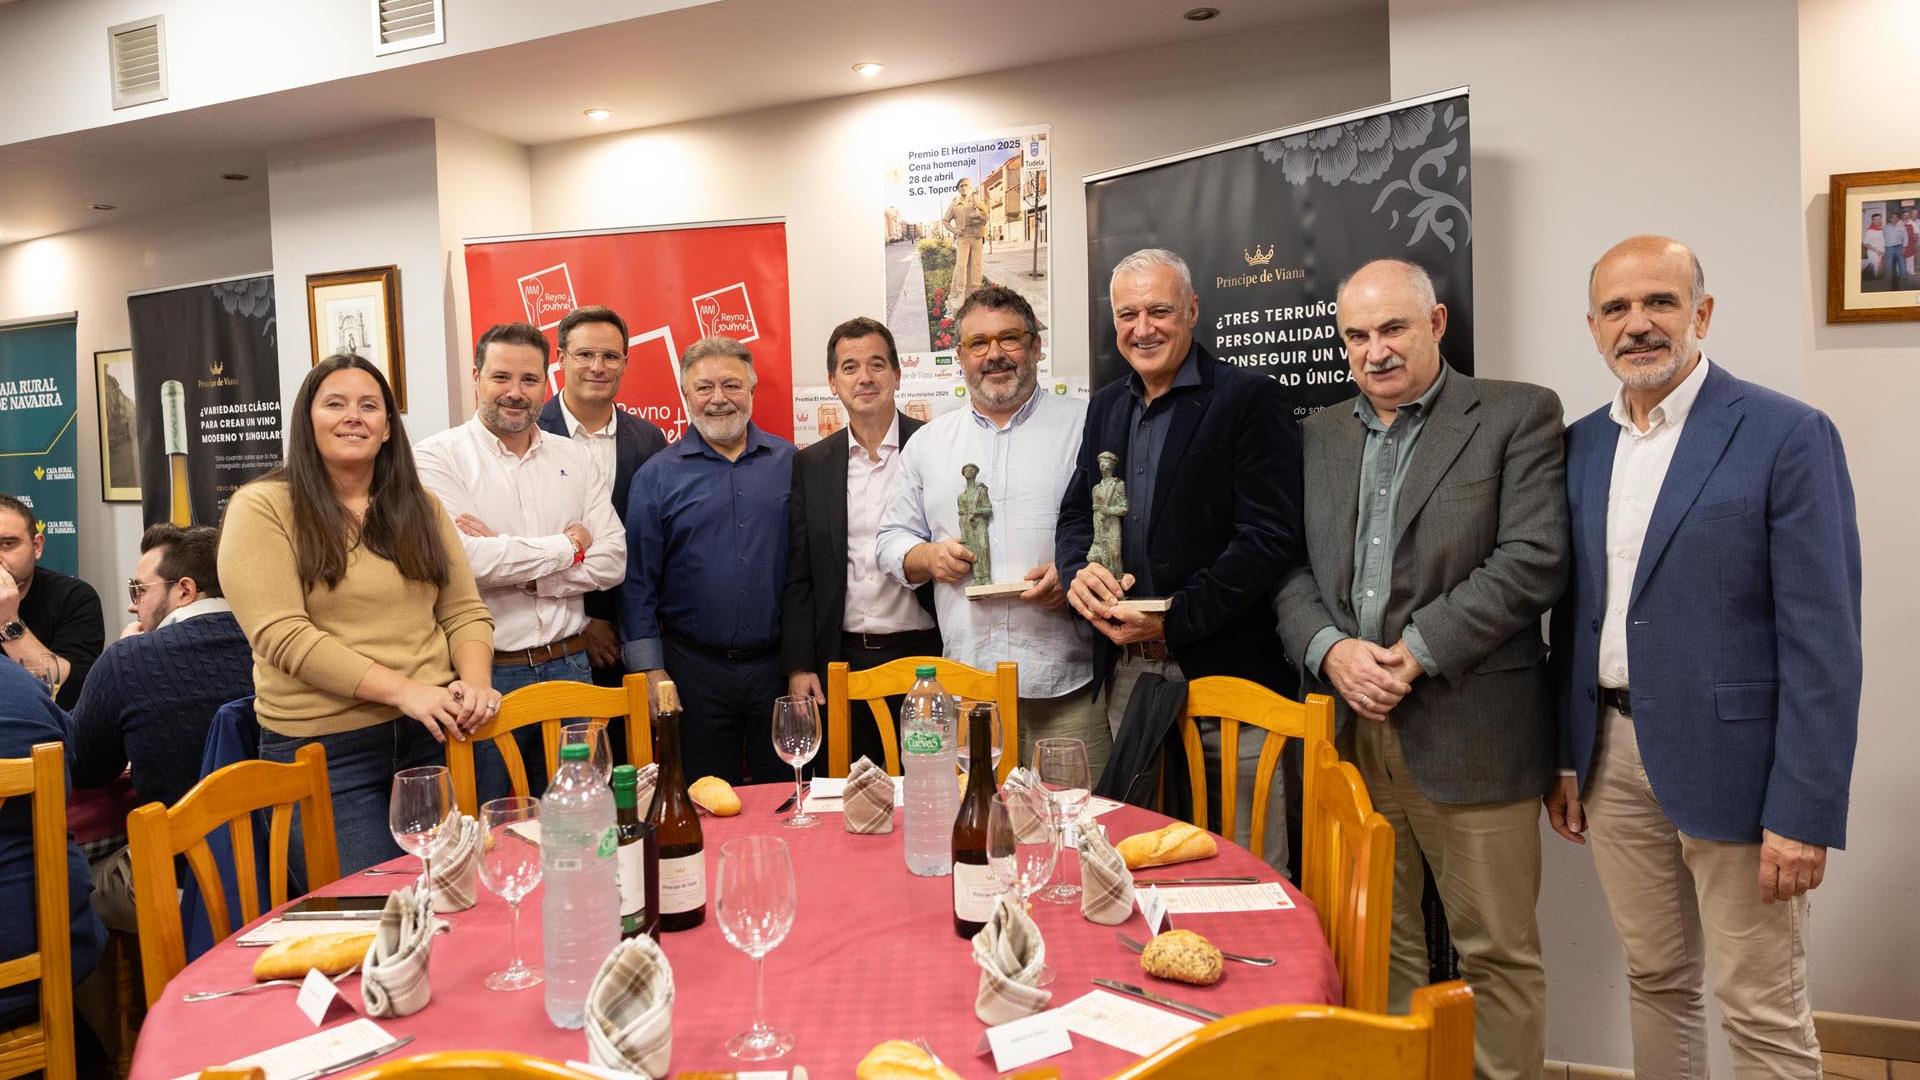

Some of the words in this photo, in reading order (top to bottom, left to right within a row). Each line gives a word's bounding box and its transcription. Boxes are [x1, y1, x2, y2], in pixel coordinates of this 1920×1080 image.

[908, 149, 939, 160] Premio
[941, 146, 950, 156] El
[951, 141, 996, 156] Hortelano
[997, 139, 1021, 151] 2025
[908, 162, 931, 172] Cena
[933, 157, 977, 170] homenaje
[1025, 159, 1045, 168] Tudela
[908, 175, 920, 184] 28
[921, 173, 933, 183] de
[934, 170, 954, 182] abril
[909, 187, 927, 197] S.G.
[928, 184, 958, 196] Topero
[1216, 273, 1258, 289] Príncipe
[1259, 269, 1273, 284] de
[1274, 267, 1305, 281] Viana
[539, 295, 575, 313] Gourmet
[545, 293, 567, 303] Reyno
[720, 312, 745, 322] Reyno
[1216, 310, 1259, 329] ¿TRES
[1264, 300, 1337, 323] TERRUÑO
[714, 314, 752, 334] Gourmet
[1216, 325, 1335, 349] PERSONALIDAD
[1312, 347, 1334, 362] UN
[217, 376, 225, 386] de
[1306, 368, 1357, 385] ÚNICA
[0, 380, 17, 396] AJA
[19, 377, 58, 393] RURAL
[10, 393, 63, 410] NAVARRA
[200, 404, 247, 417] ¿VARIEDADES
[248, 400, 280, 412] CLÁSICA
[201, 420, 218, 430] PARA
[219, 418, 245, 428] CREAR
[246, 418, 255, 427] UN
[257, 416, 276, 426] VINO
[202, 433, 237, 443] MODERNO
[239, 433, 244, 441] Y
